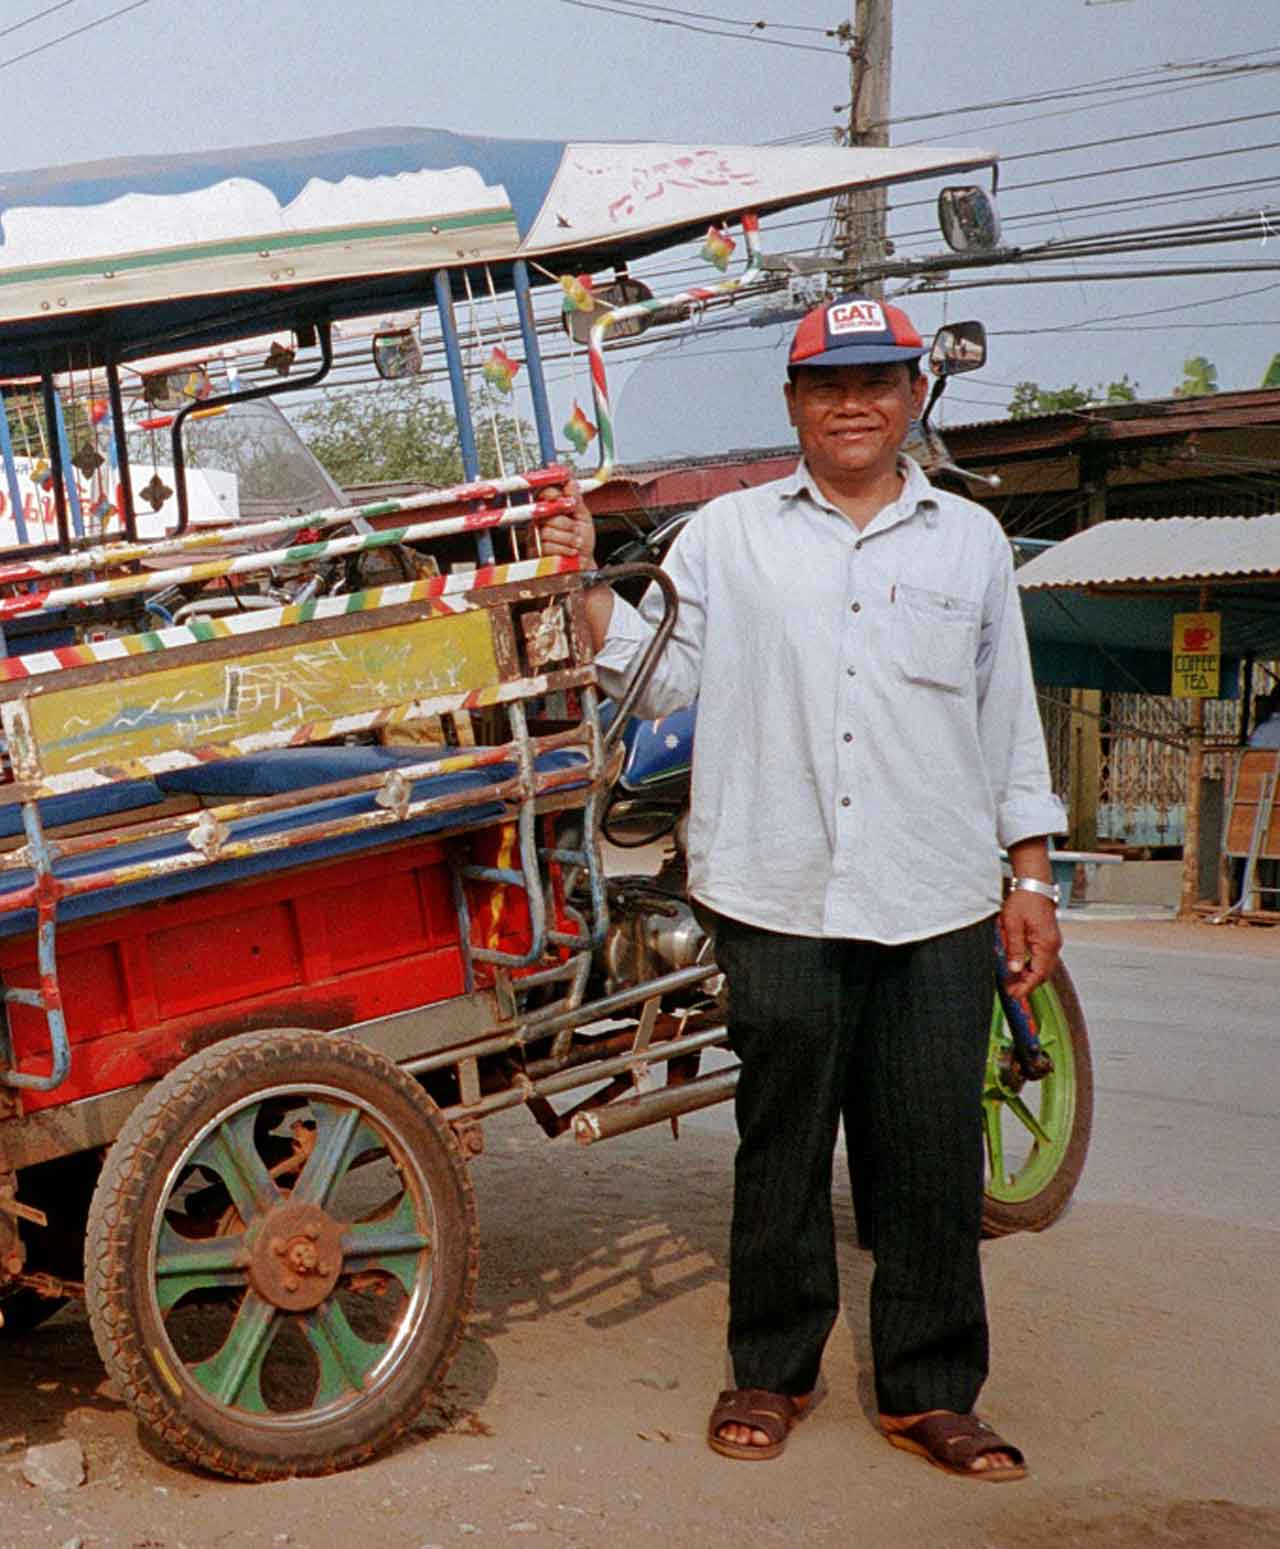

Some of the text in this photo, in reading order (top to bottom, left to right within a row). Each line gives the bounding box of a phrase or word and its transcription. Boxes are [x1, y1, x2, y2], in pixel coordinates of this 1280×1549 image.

[832, 304, 878, 322] CAT
[1175, 655, 1217, 672] COFFEE
[1182, 673, 1209, 690] TEA
